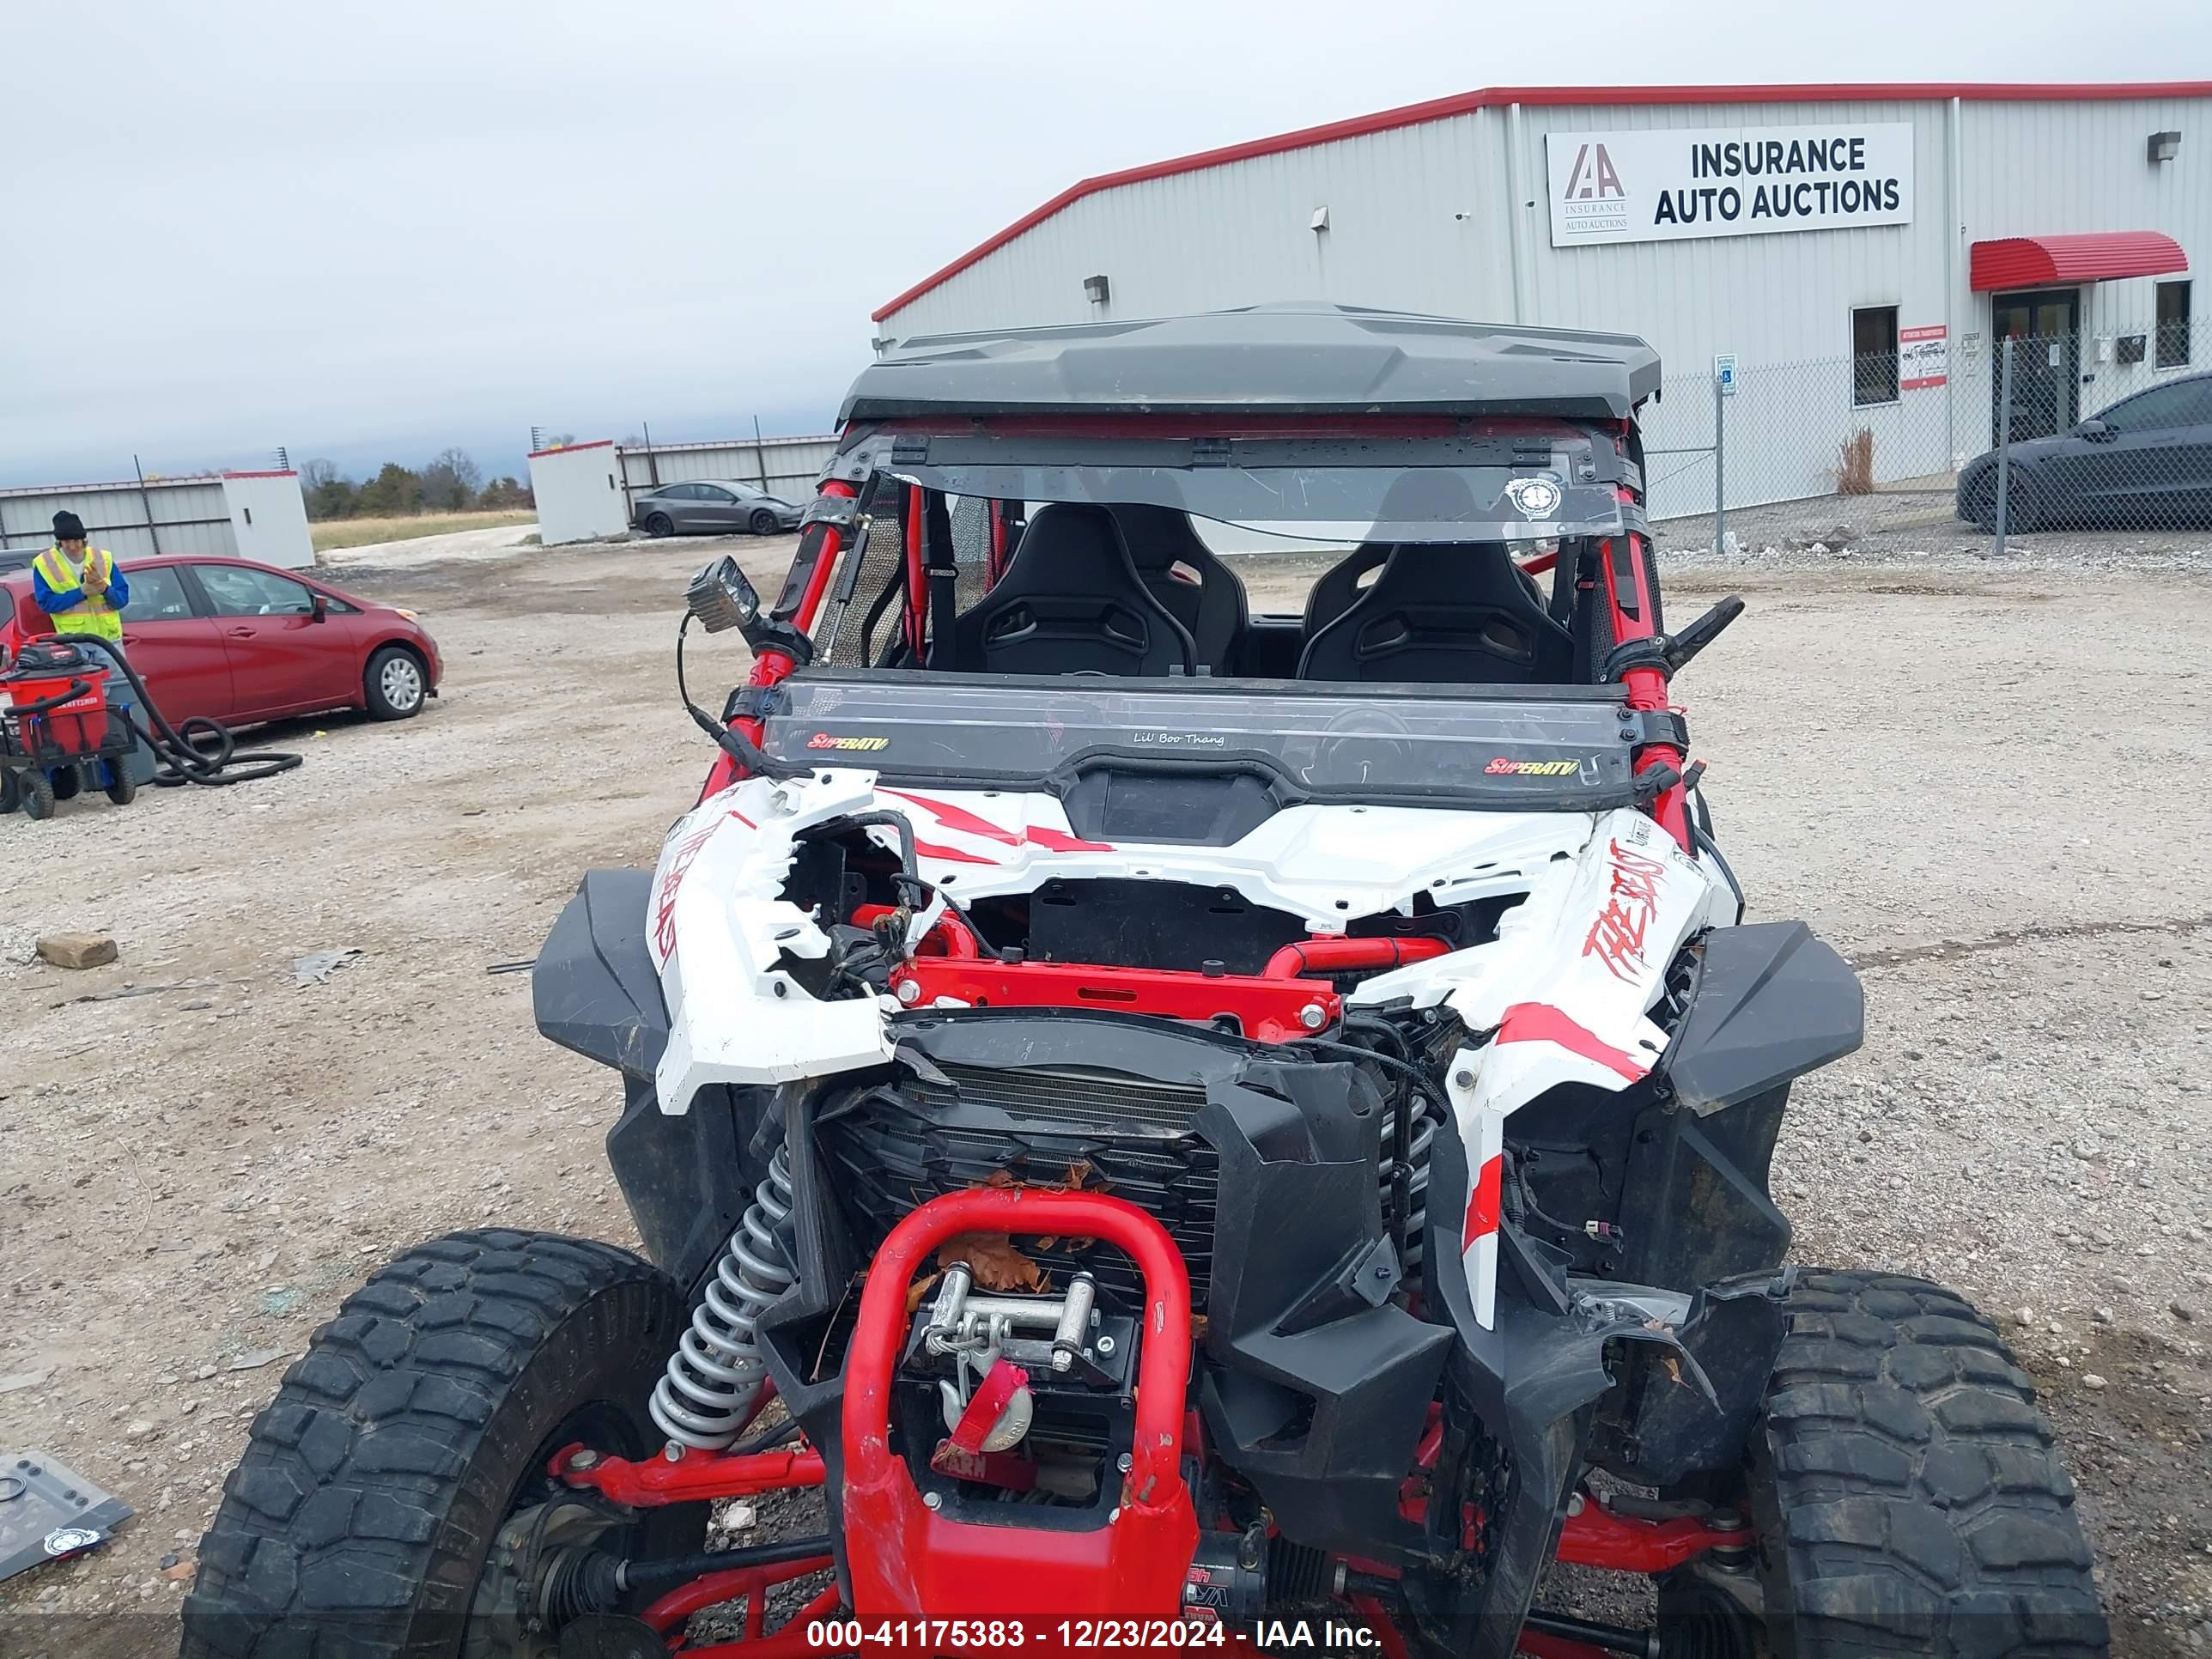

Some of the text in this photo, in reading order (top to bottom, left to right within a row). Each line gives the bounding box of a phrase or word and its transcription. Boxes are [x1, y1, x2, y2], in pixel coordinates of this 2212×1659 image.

[1692, 137, 1864, 178] INSURANCE
[1565, 203, 1626, 214] INSURANCE
[1654, 179, 1899, 224] AUTO AUCTIONS
[1566, 219, 1627, 230] AUTO AUCTIONS
[1159, 733, 1181, 744] Boo
[1185, 734, 1224, 747] Thang
[1582, 837, 1670, 988] THE BEAST
[994, 1418, 1027, 1448] WARN
